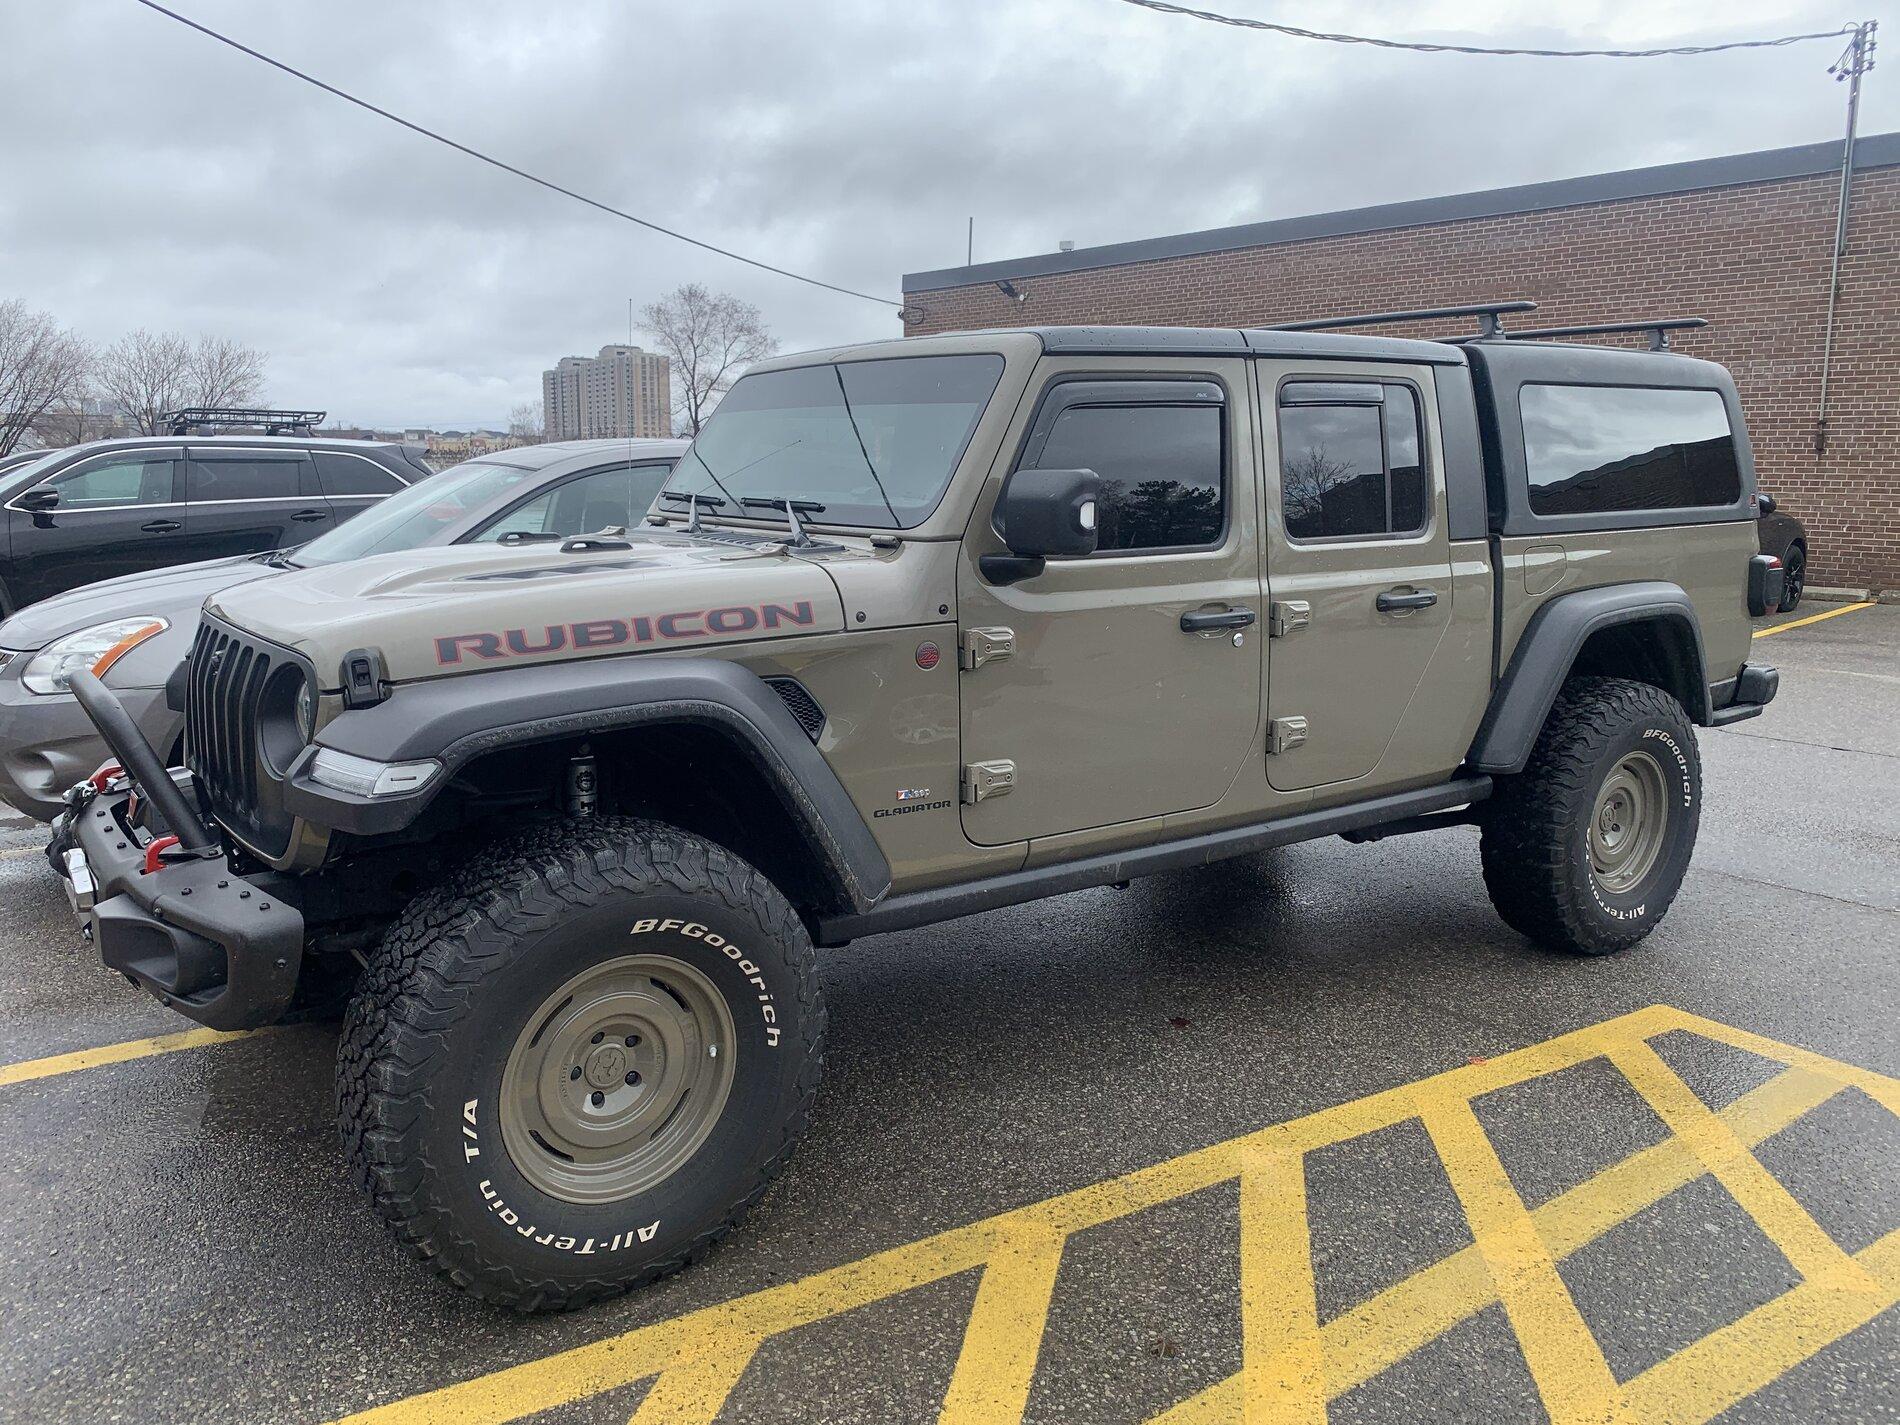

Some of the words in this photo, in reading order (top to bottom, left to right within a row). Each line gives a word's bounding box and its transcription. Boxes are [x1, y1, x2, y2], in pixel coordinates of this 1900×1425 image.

[433, 601, 815, 666] RUBICON
[1642, 729, 1692, 807] BFGoodrich
[873, 800, 952, 818] GLADIATOR
[630, 918, 781, 1047] BFGoodrich
[462, 1098, 480, 1164] T/A
[479, 1179, 661, 1255] All-Terrain
